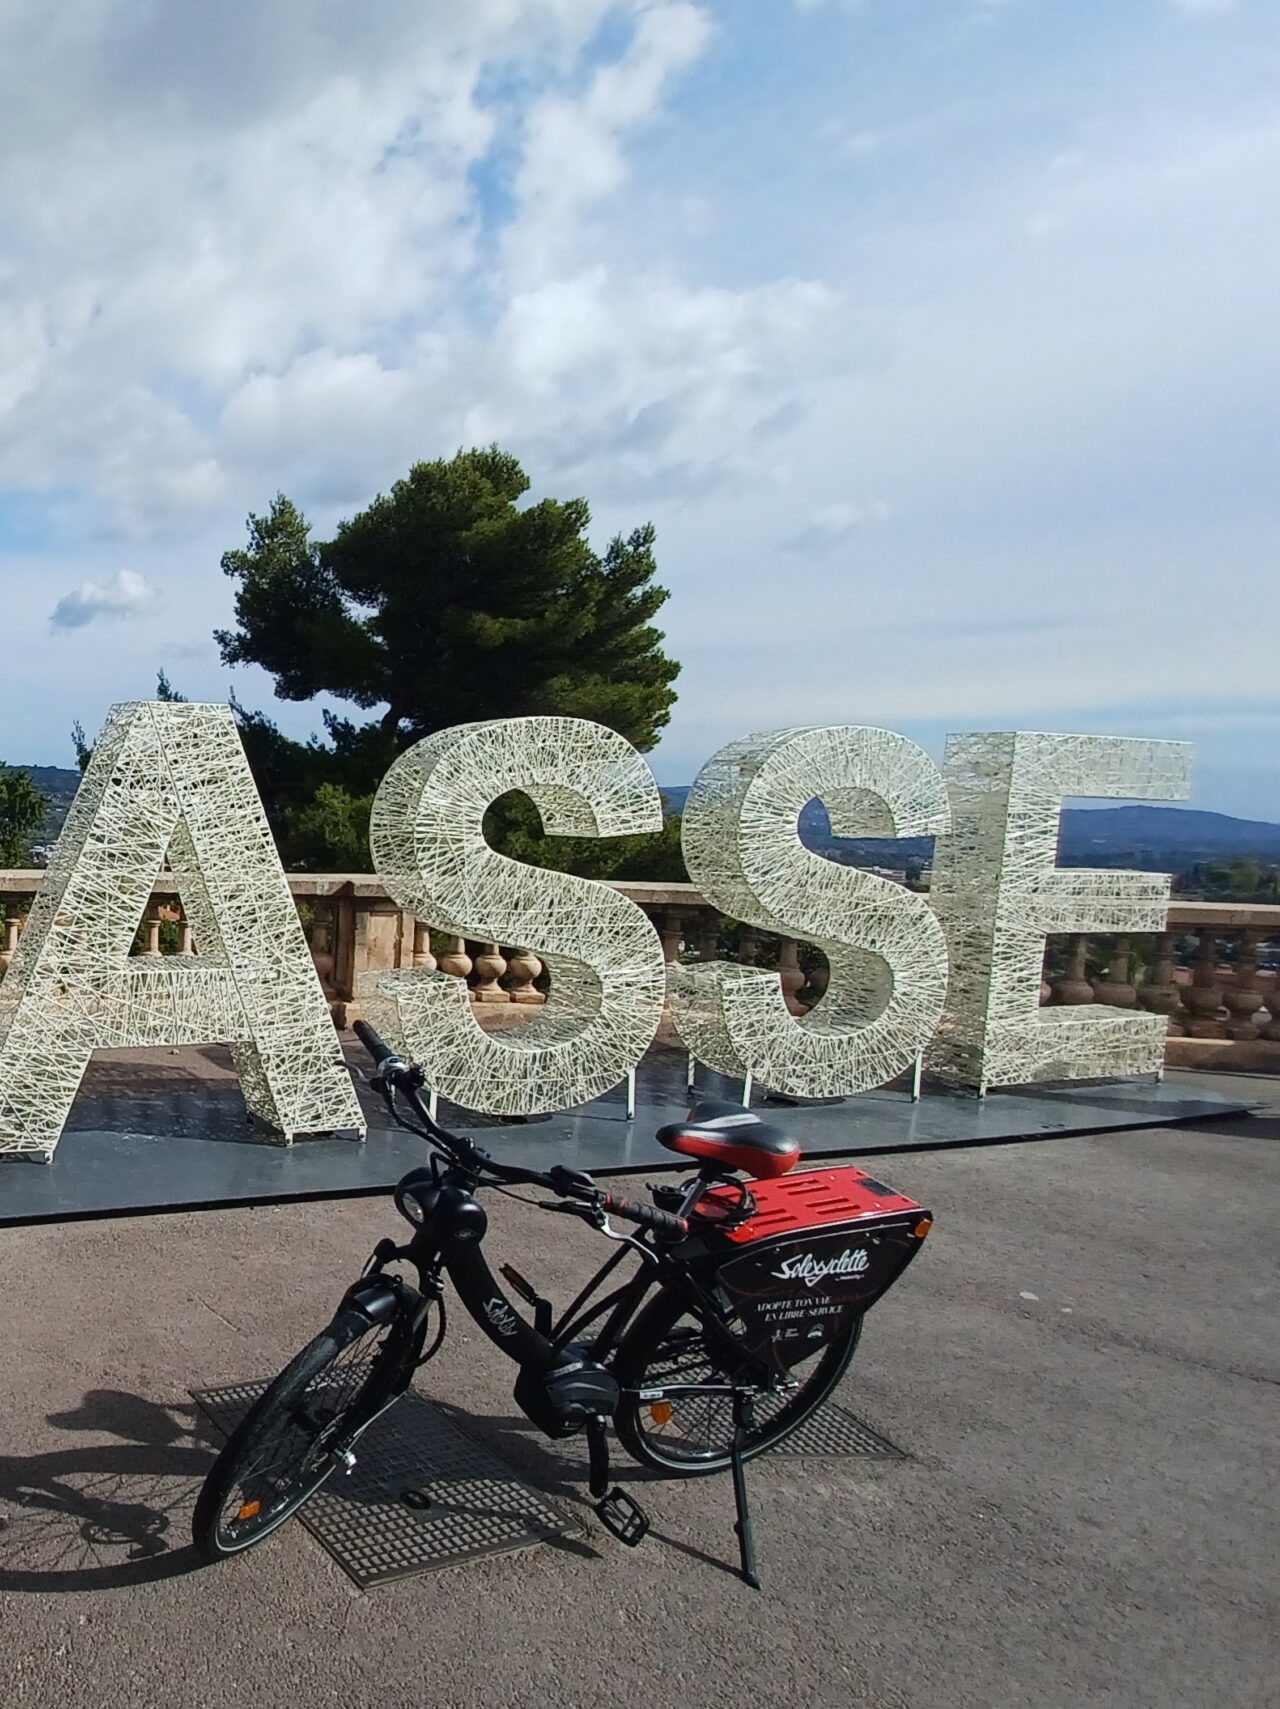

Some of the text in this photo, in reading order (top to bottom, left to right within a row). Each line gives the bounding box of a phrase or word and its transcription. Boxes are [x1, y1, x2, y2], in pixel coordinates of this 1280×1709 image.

[771, 1249, 870, 1287] Solexyclette
[757, 1300, 793, 1311] ADOPTE
[795, 1298, 813, 1307] TON
[765, 1305, 845, 1322] EN LIBRE SERVICE
